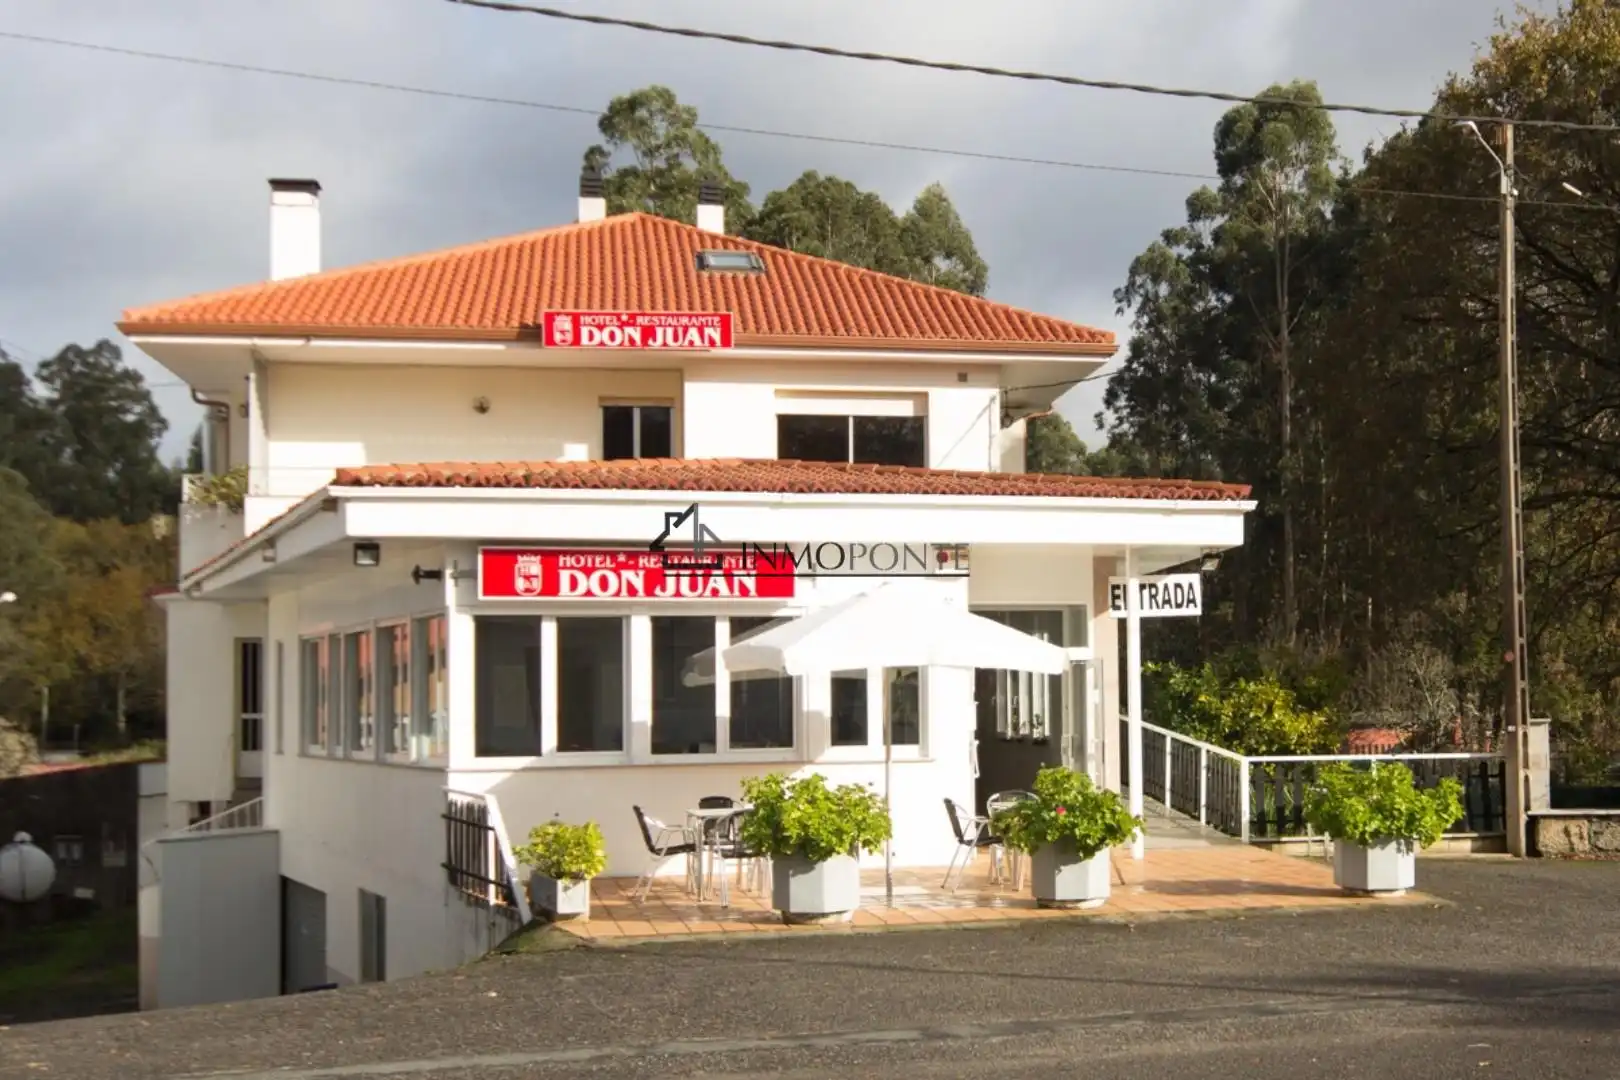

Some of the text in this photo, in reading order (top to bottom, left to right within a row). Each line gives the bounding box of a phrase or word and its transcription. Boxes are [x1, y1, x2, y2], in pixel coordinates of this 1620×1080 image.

[635, 315, 722, 326] RESTAURANTE
[580, 326, 722, 347] DON JUAN
[638, 554, 756, 569] RETARNTE
[558, 569, 758, 597] DON JUAN
